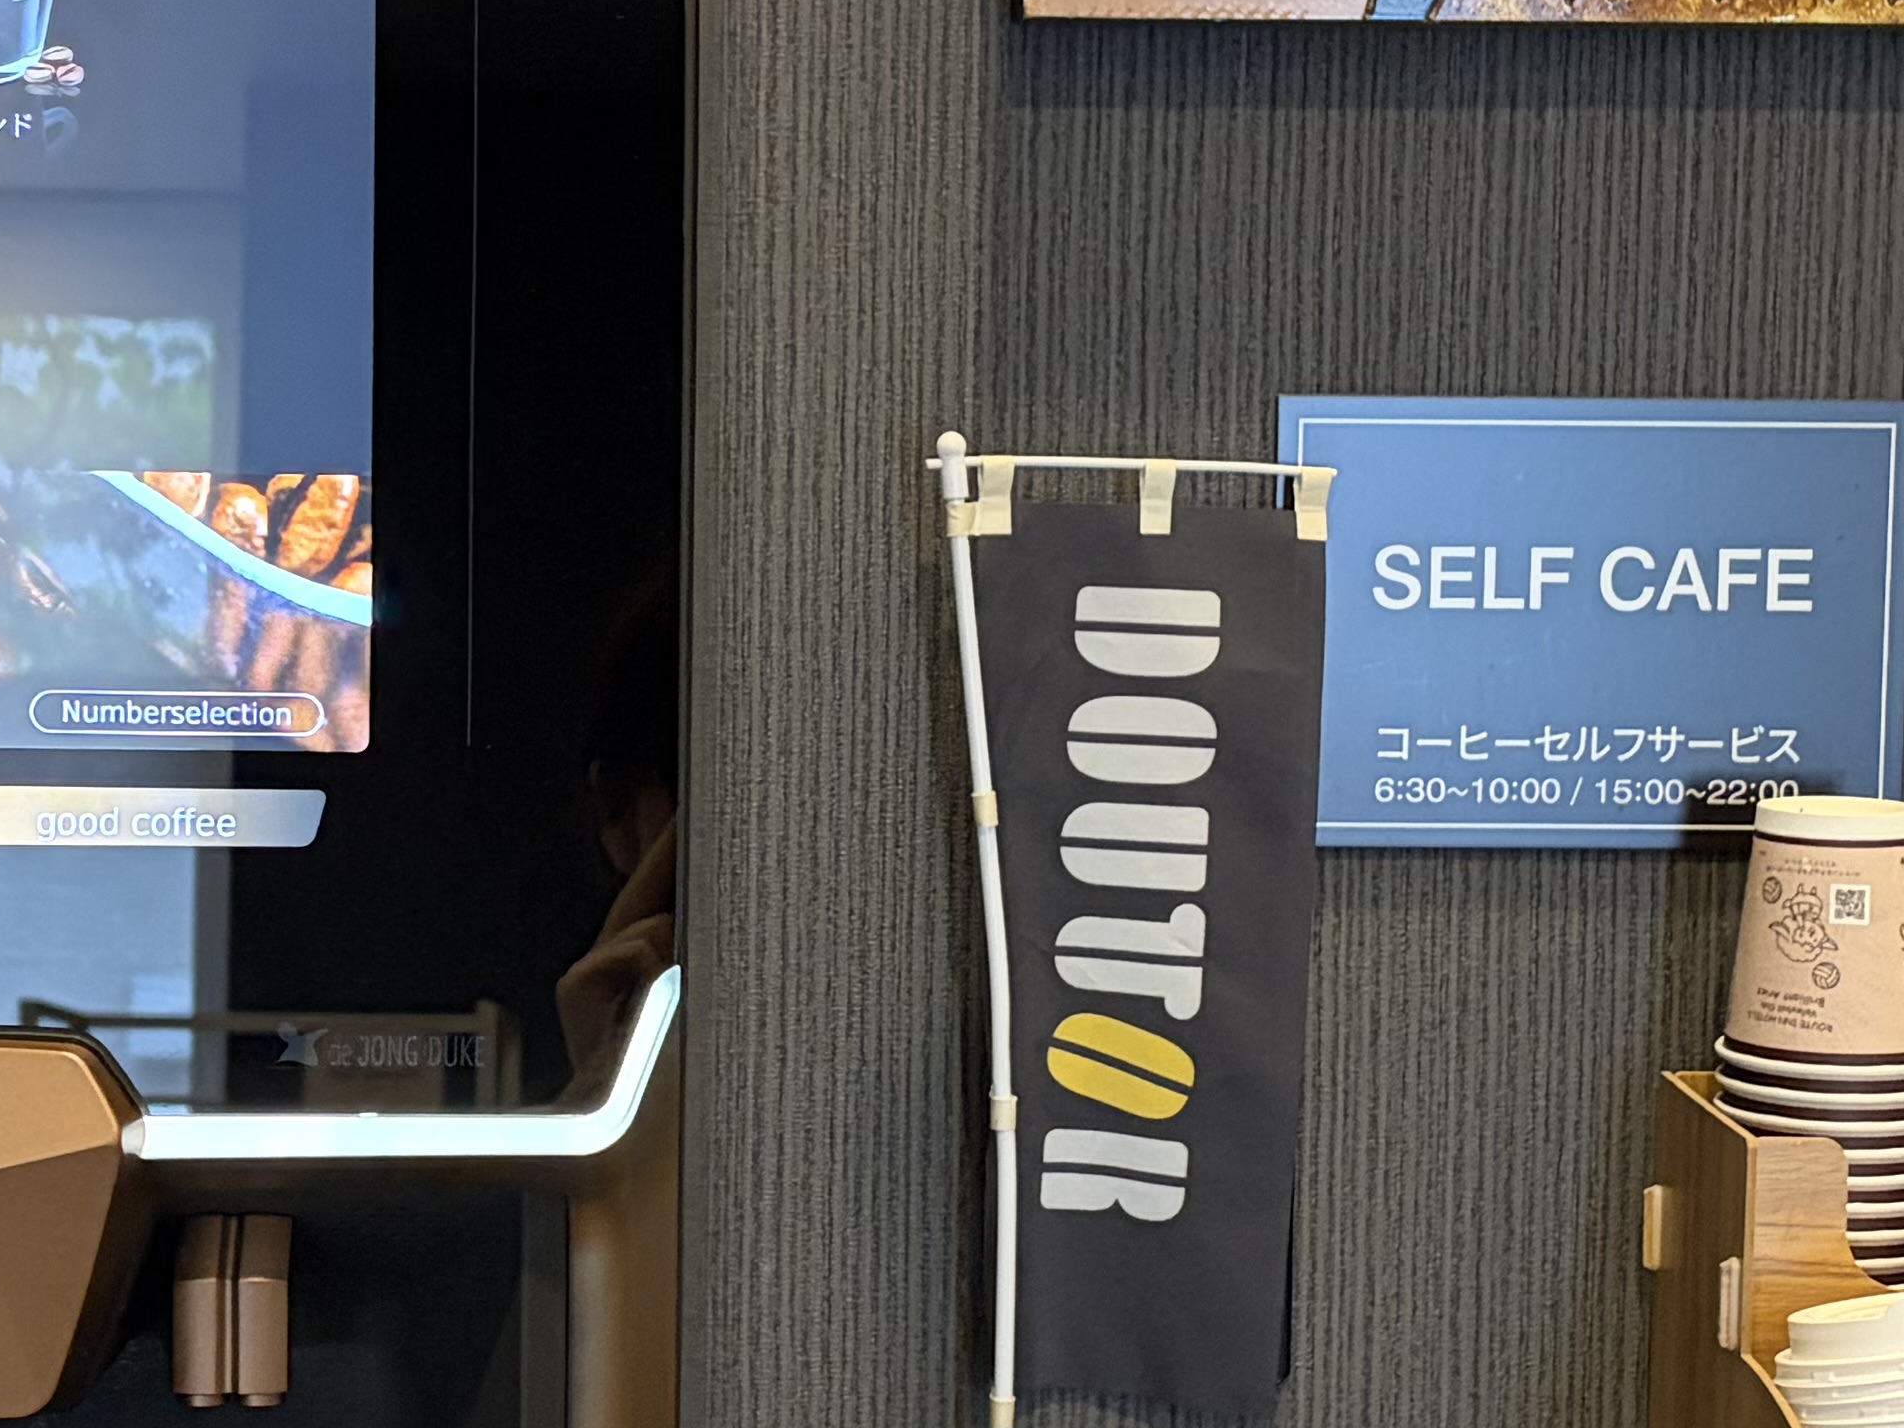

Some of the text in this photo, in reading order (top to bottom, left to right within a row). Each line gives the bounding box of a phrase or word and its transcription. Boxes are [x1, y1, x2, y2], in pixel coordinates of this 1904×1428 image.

[1372, 544, 1814, 613] SELF CAFE
[61, 699, 293, 727] Numberselection
[1376, 724, 1802, 765] コーヒーセルフサービス
[36, 806, 237, 842] good coffee
[1040, 585, 1222, 1222] DOUTOR
[356, 1035, 419, 1068] JONG
[428, 1035, 486, 1068] DUKE
